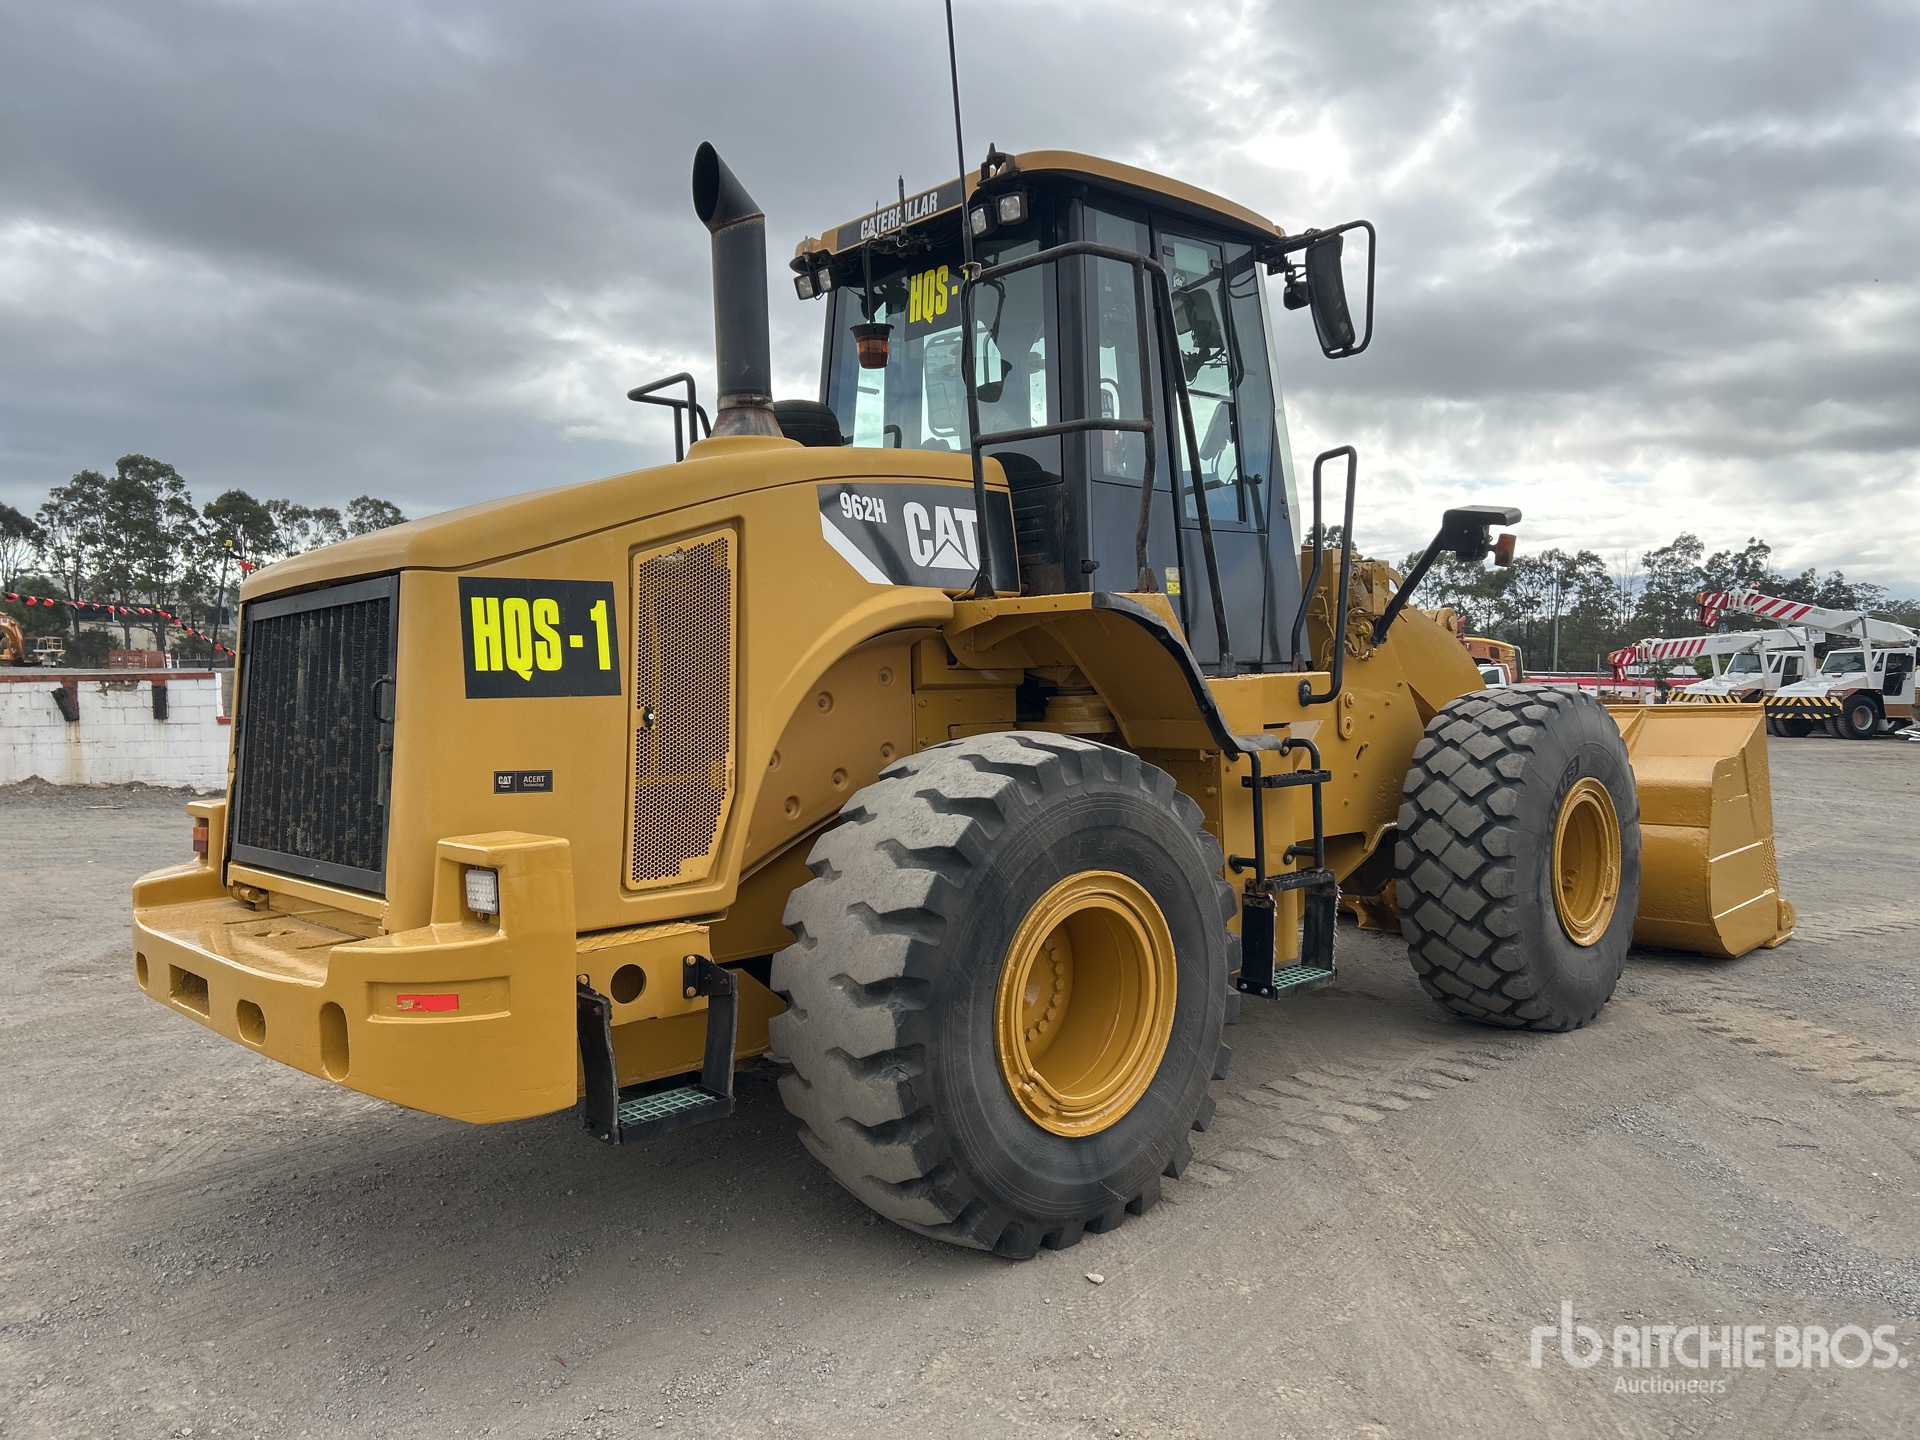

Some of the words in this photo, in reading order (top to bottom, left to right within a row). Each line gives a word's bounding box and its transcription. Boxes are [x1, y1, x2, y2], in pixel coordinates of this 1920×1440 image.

[839, 491, 887, 524] 962H
[903, 501, 980, 570] CAT
[498, 776, 512, 784] CAT
